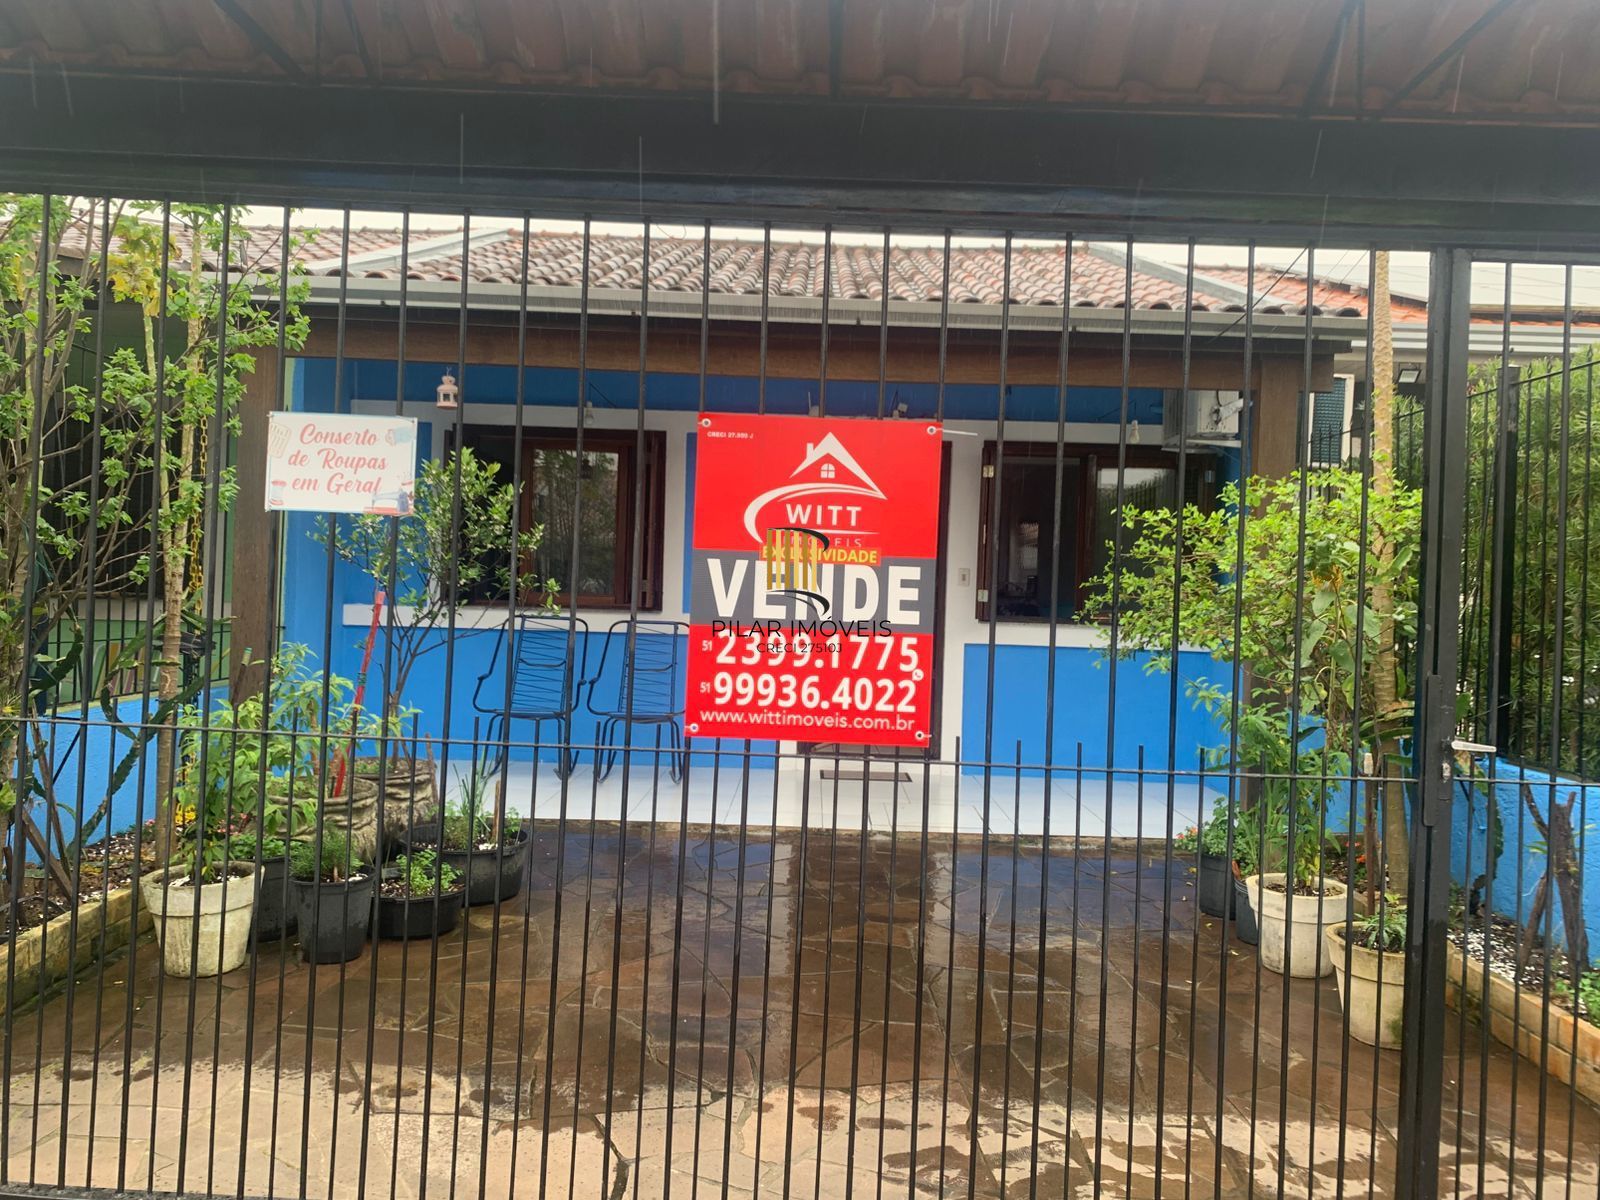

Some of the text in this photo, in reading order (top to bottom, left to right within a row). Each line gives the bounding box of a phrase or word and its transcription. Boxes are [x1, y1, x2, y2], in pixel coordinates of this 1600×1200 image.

[300, 423, 378, 446] Conserto
[288, 448, 388, 474] de Roupas
[292, 472, 382, 495] em Geral
[786, 503, 862, 527] WITT
[783, 537, 862, 548] IMEIS
[707, 558, 921, 625] VENDE
[702, 629, 919, 672] 51 2399.1775
[700, 671, 916, 713] 51 99936.4022
[700, 709, 915, 731] www.wittimoveis.com.br
